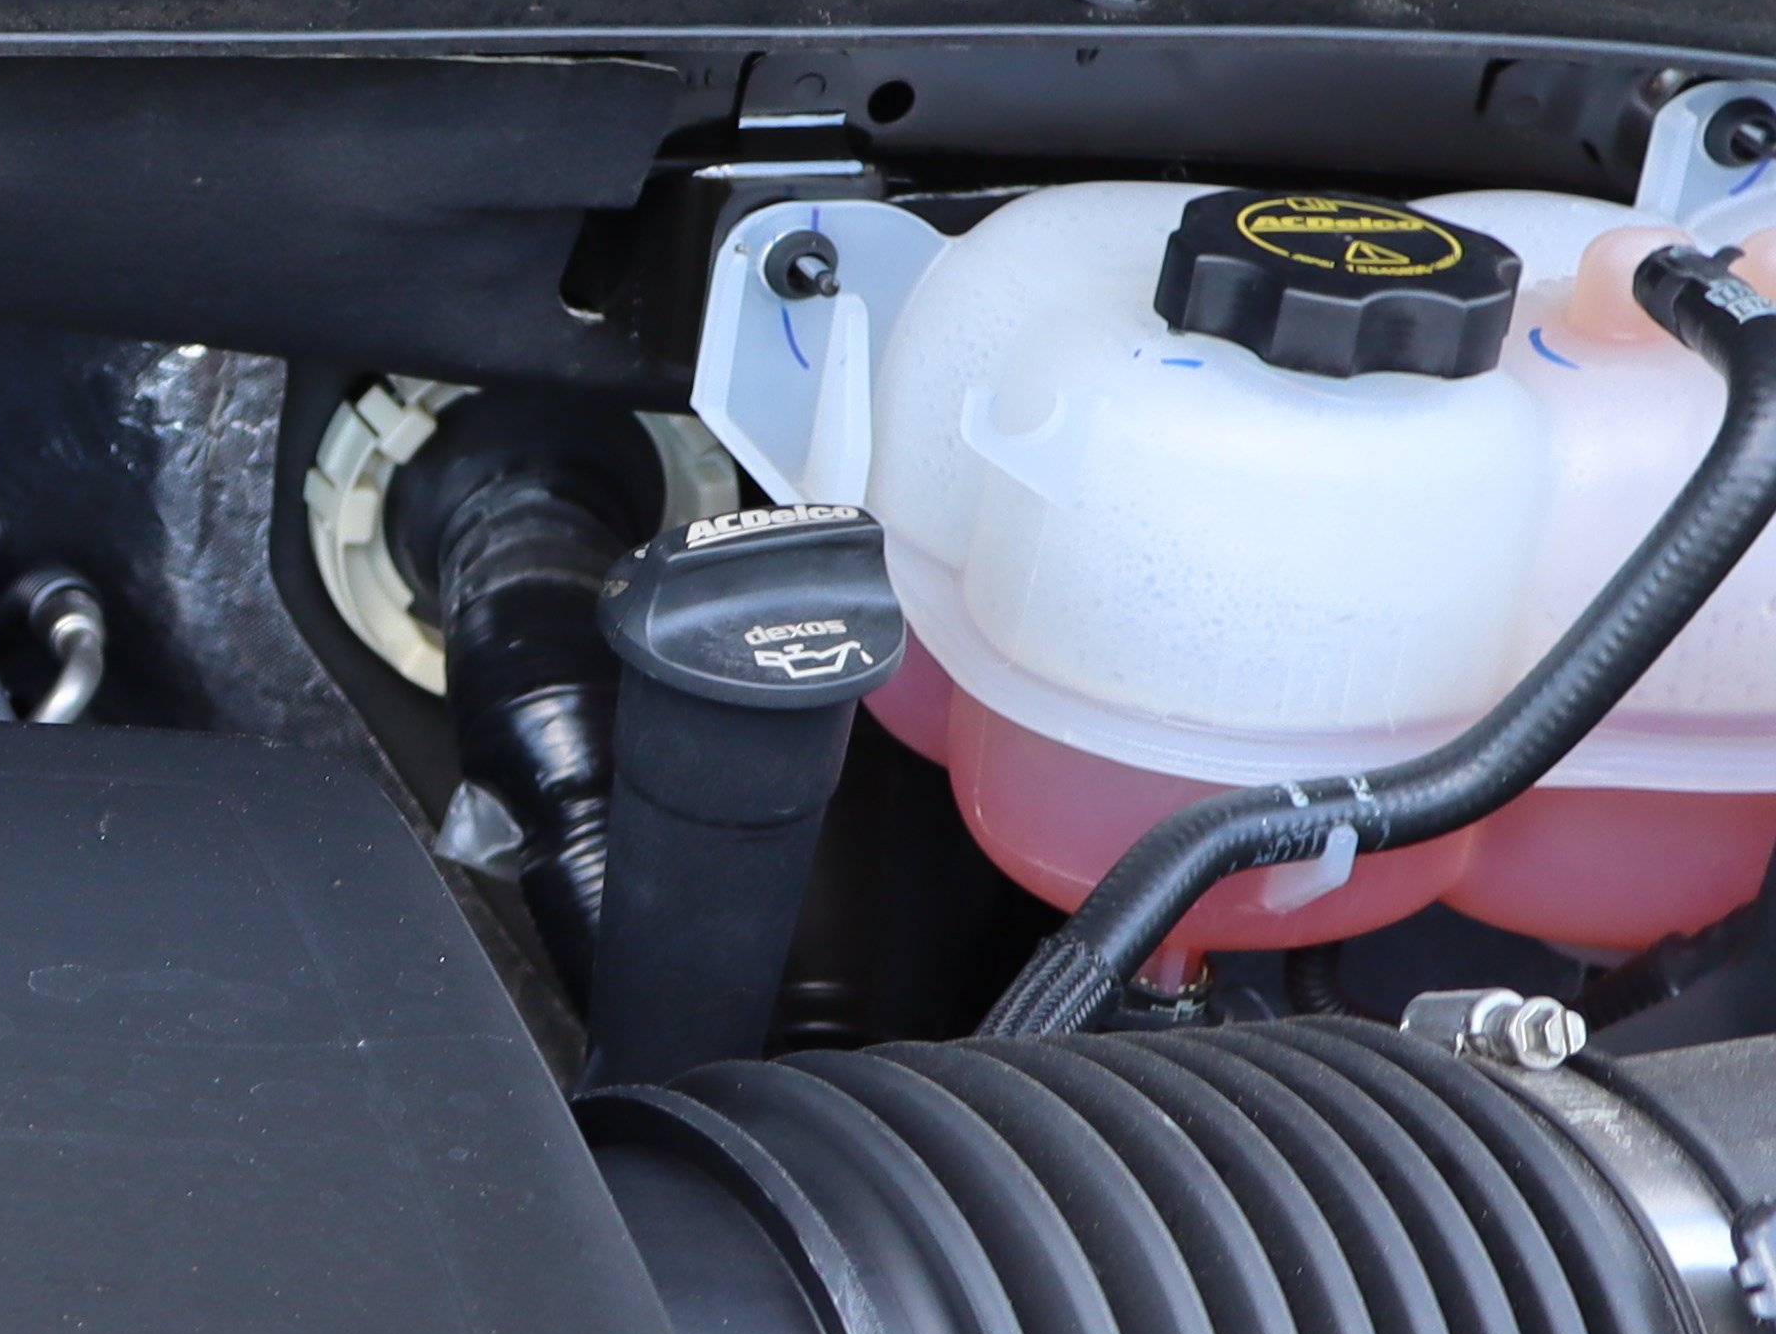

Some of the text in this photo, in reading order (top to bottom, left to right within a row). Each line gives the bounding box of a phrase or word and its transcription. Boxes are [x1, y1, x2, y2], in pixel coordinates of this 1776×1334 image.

[1251, 215, 1425, 230] ACDelco
[686, 505, 860, 544] ACDelco
[744, 619, 847, 646] dexos
